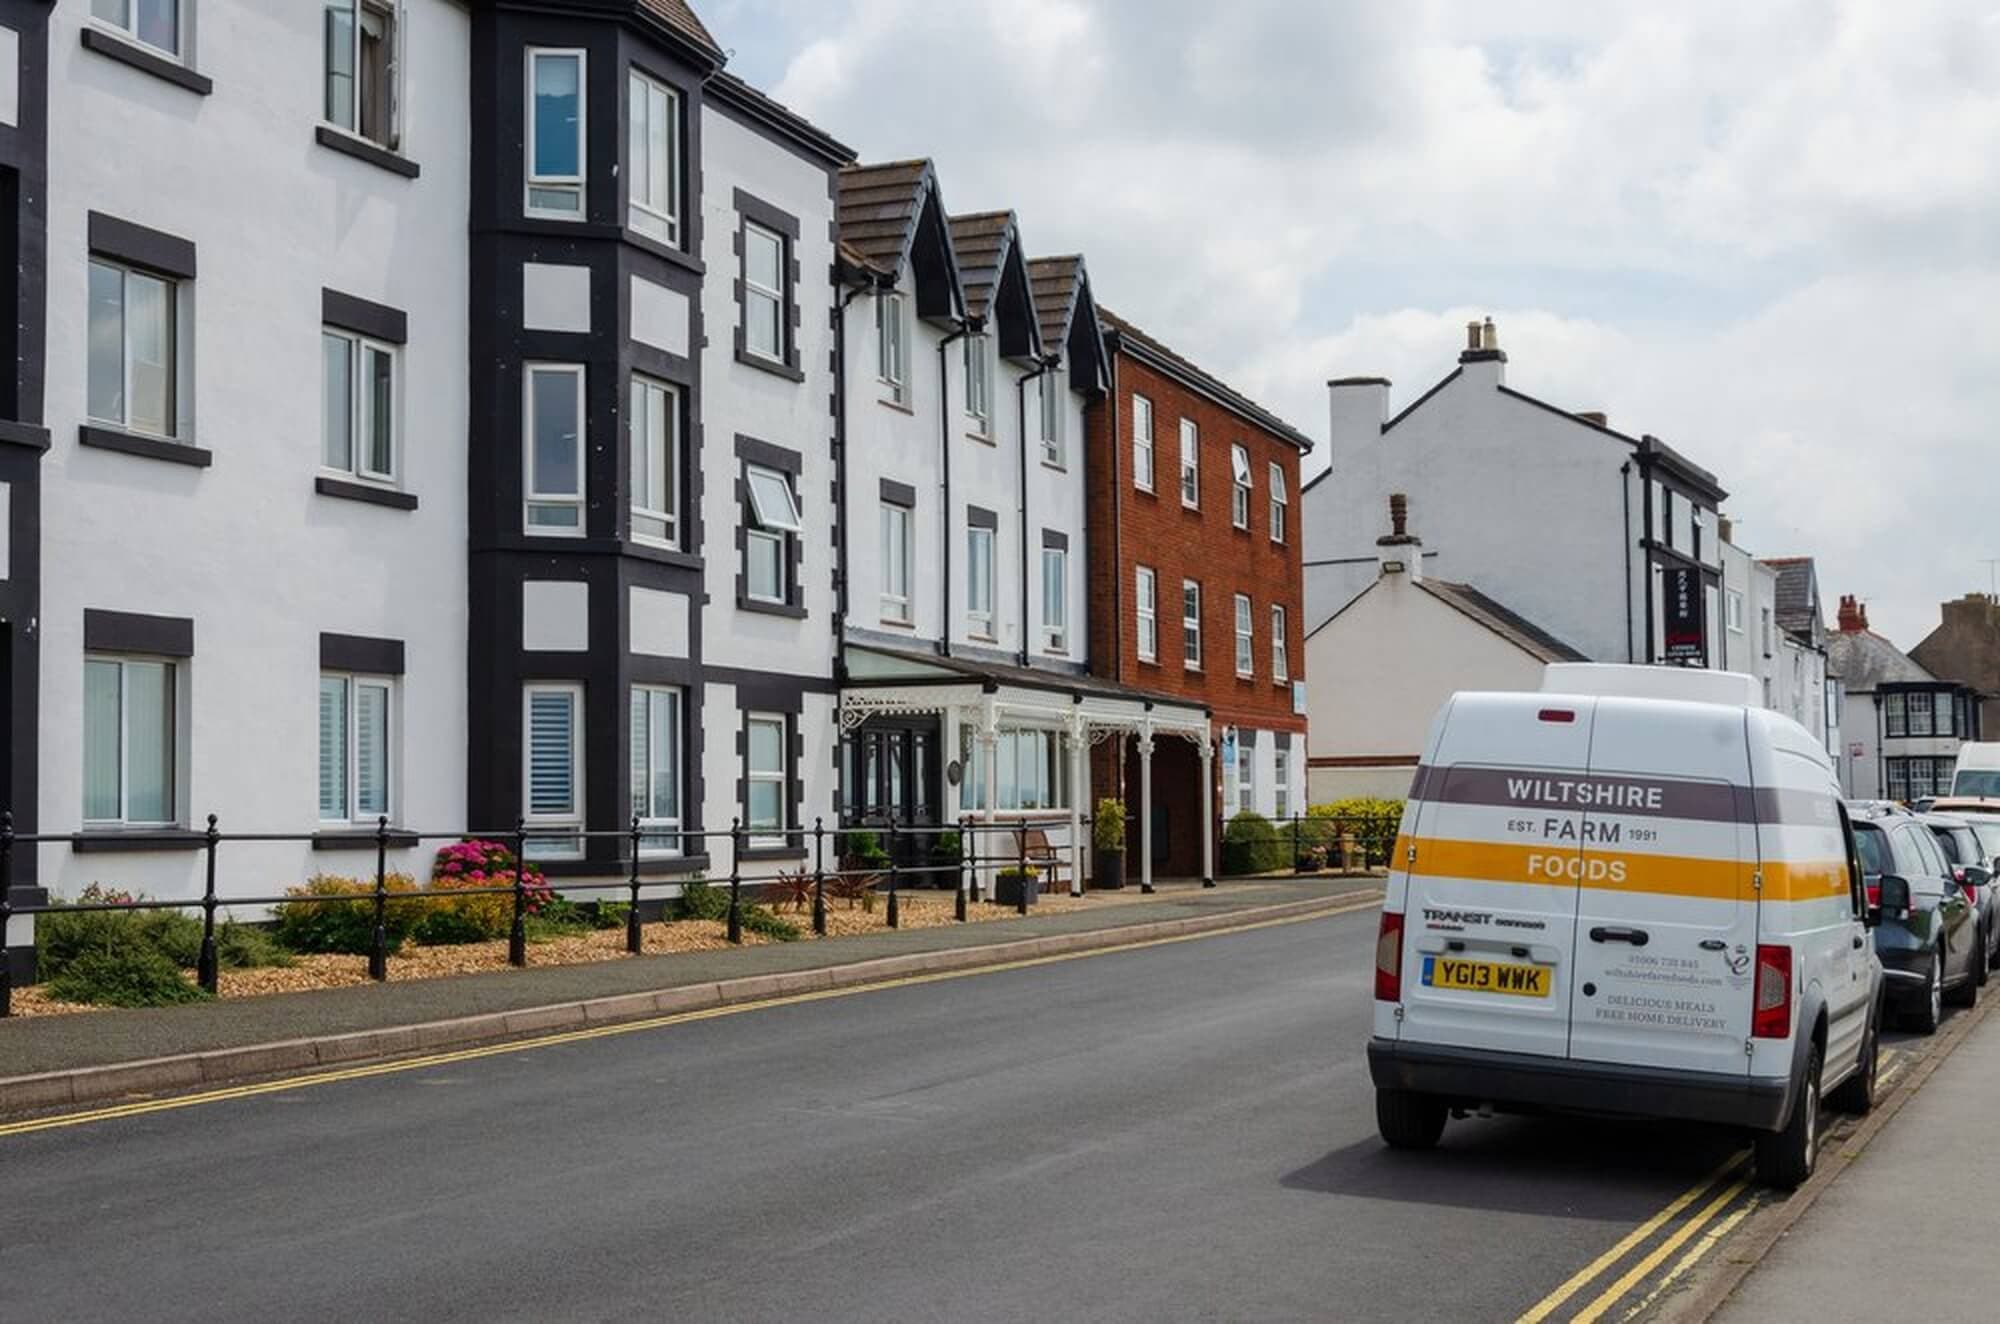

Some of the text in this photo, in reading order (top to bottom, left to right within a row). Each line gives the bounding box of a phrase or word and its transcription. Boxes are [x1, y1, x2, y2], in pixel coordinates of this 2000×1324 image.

[1507, 778, 1663, 809] WILTSHIRE
[1507, 818, 1658, 843] EST. FARM 1991
[1527, 854, 1627, 882] FOODS
[1422, 908, 1493, 925] TRANSIT
[1442, 961, 1542, 992] YG13 WWK
[1607, 994, 1715, 1013] DELICIOUS MEALS
[1596, 1008, 1728, 1030] FREE HOME DELIVERY
